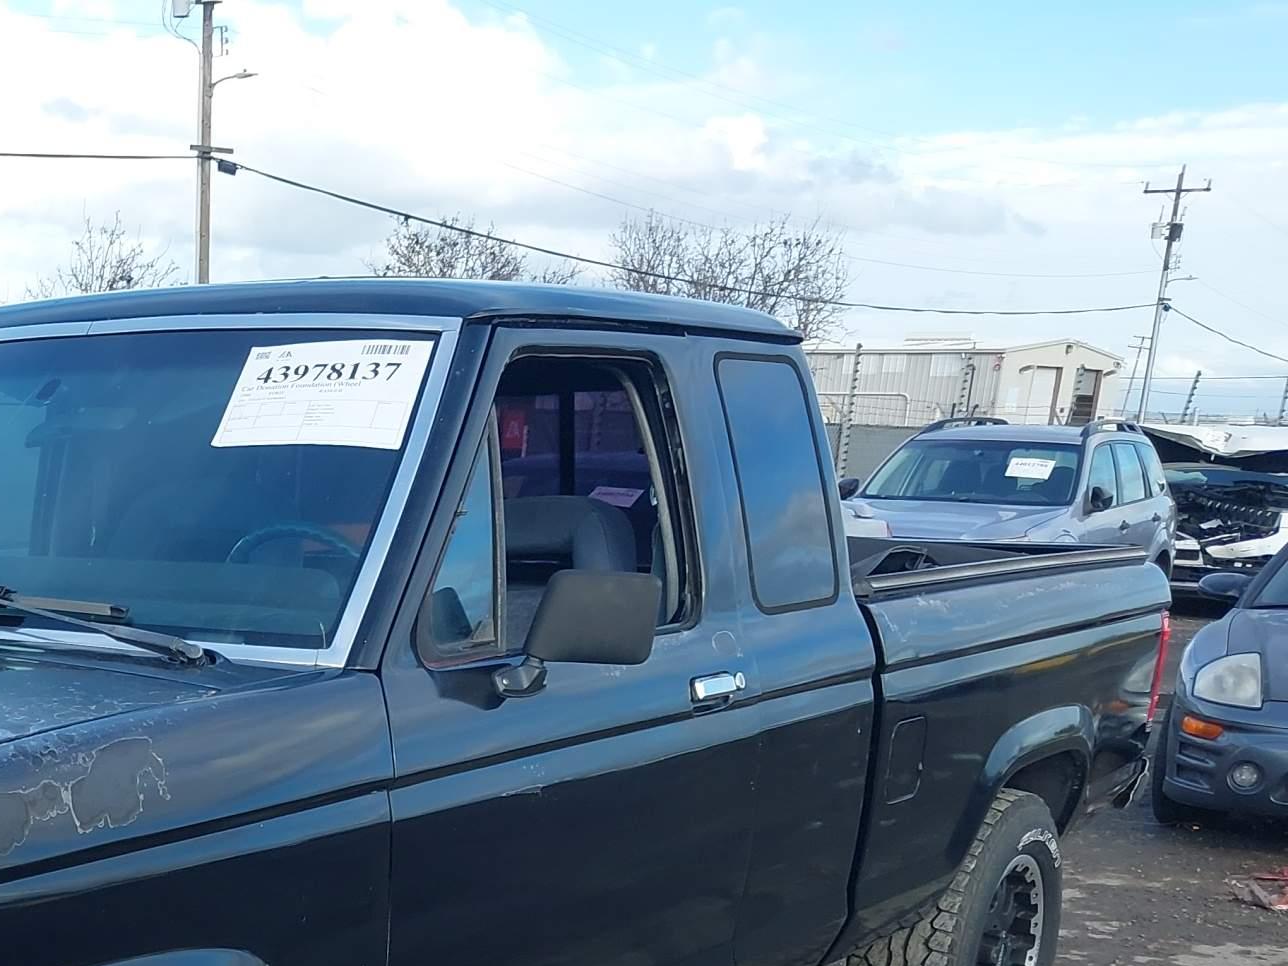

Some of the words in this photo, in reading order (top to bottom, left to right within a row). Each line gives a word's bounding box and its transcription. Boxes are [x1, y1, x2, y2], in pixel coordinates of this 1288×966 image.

[256, 361, 402, 385] 43978137
[256, 379, 290, 392] Donation
[290, 378, 333, 389] Foundation
